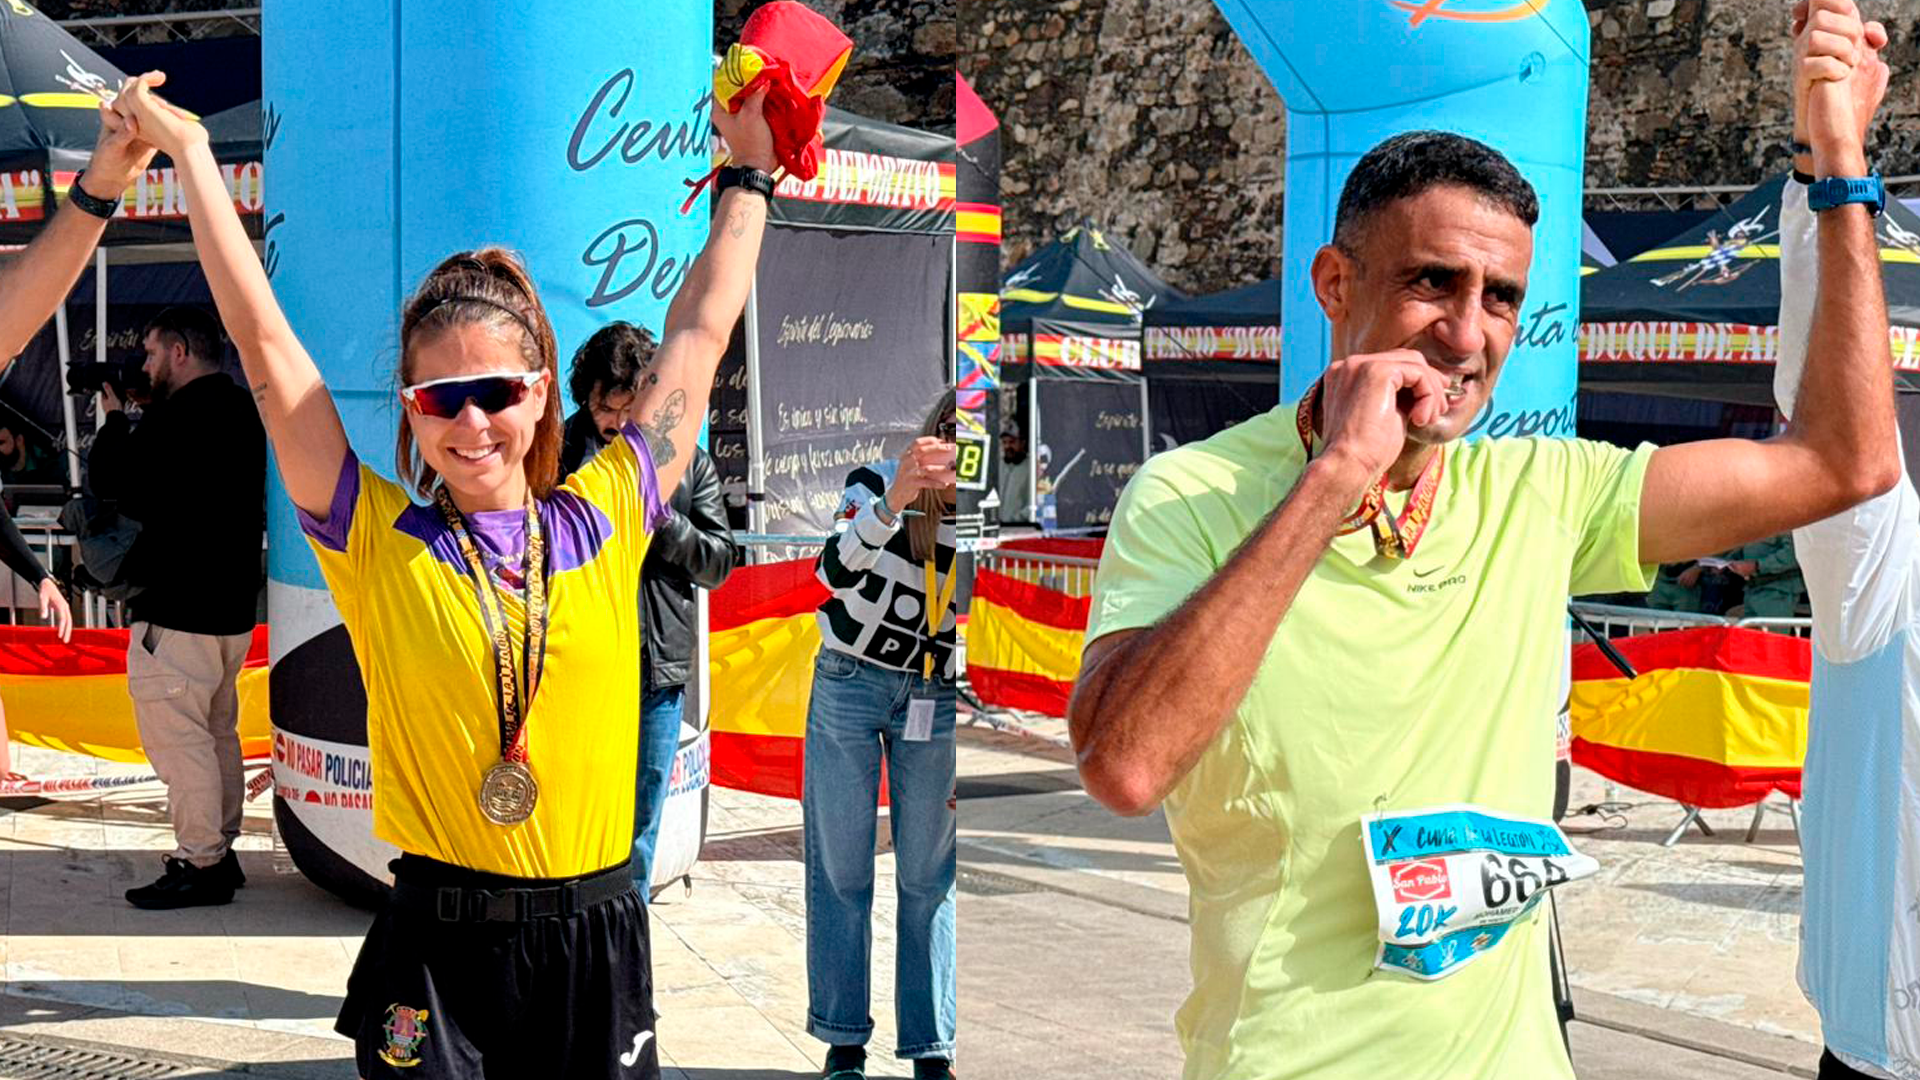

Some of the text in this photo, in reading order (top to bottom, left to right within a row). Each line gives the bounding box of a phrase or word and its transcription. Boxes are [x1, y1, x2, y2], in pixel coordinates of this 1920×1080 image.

[822, 148, 941, 209] DEPORTIVO
[1694, 322, 1733, 361] DE
[956, 444, 981, 477] 8
[1407, 575, 1467, 594] NIKE PRO
[286, 738, 373, 790] NO PASAR POLICIA
[1381, 826, 1403, 856] X
[1393, 873, 1447, 889] San Pablo
[1395, 903, 1458, 938] 20K
